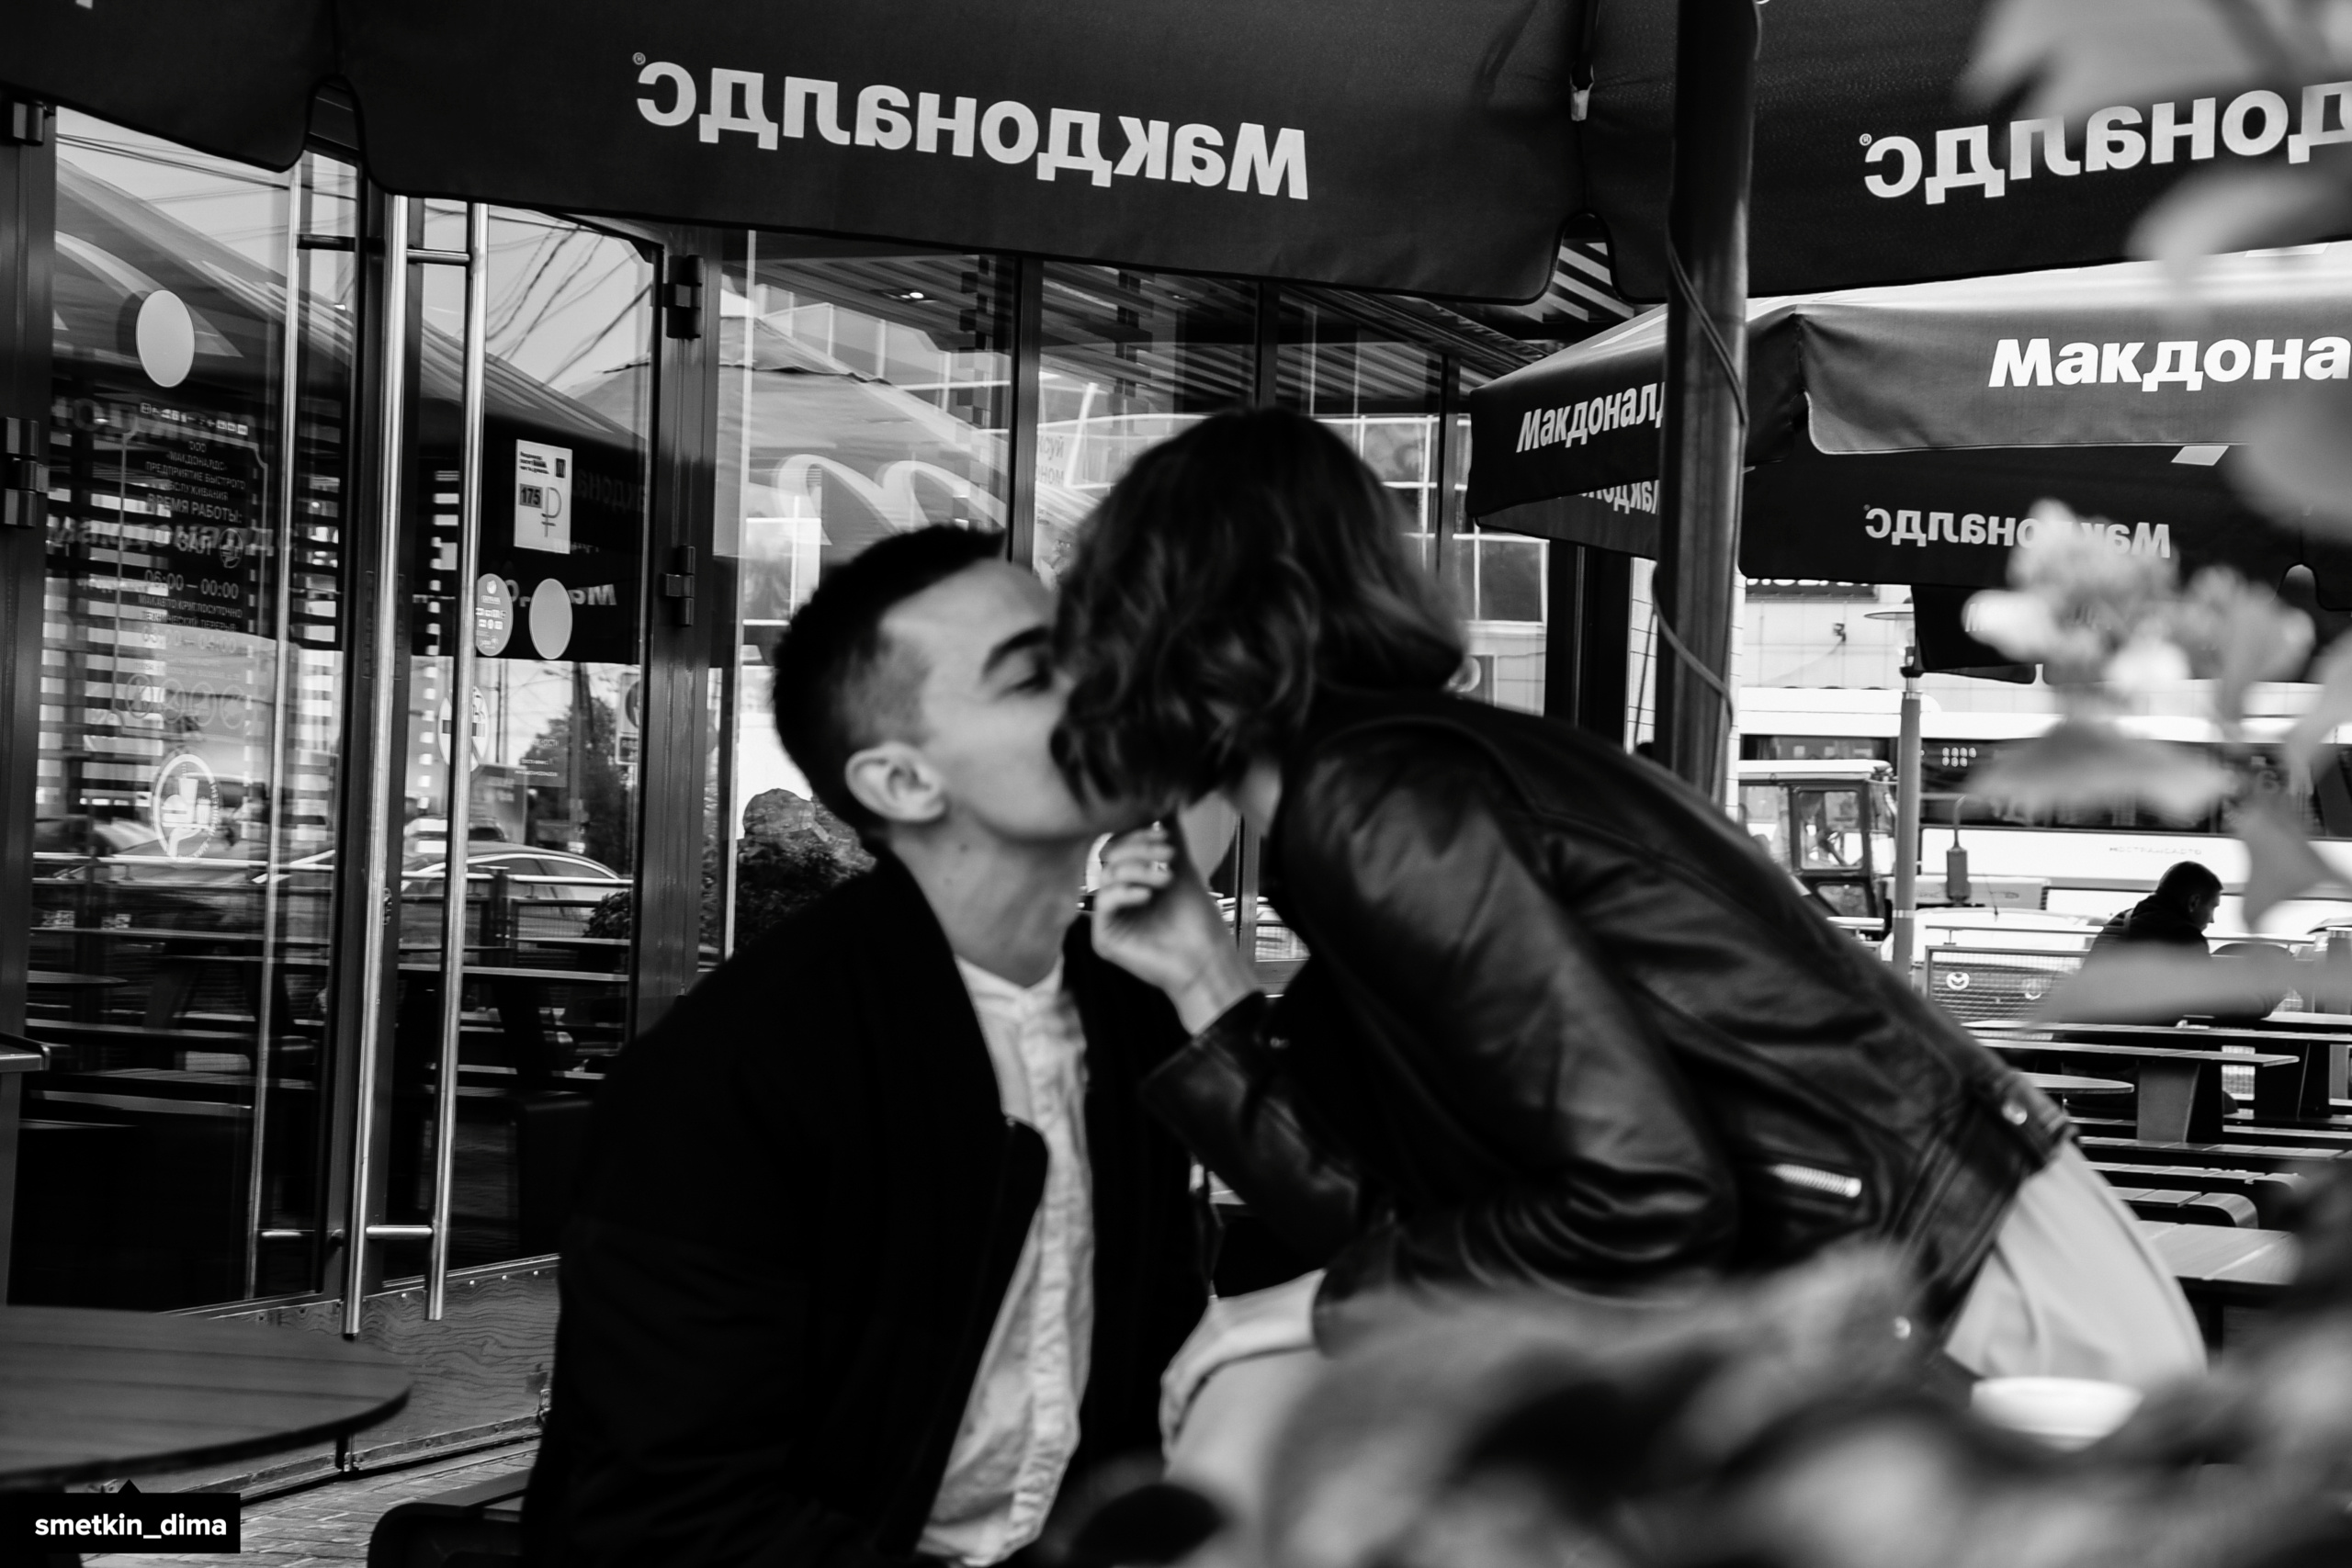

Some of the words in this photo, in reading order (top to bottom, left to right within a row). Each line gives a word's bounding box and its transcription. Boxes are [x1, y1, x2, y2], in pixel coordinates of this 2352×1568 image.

[188, 441, 207, 453] ООО
[145, 460, 202, 481] ПРЕДПРИЯТИЕ
[204, 473, 246, 490] БЫСТРОГО
[148, 493, 189, 514] ВРЕМЯ
[191, 501, 243, 524] РАБОТЫ:
[520, 487, 541, 506] 175
[144, 570, 184, 591] 06:00
[200, 578, 239, 599] 00:00
